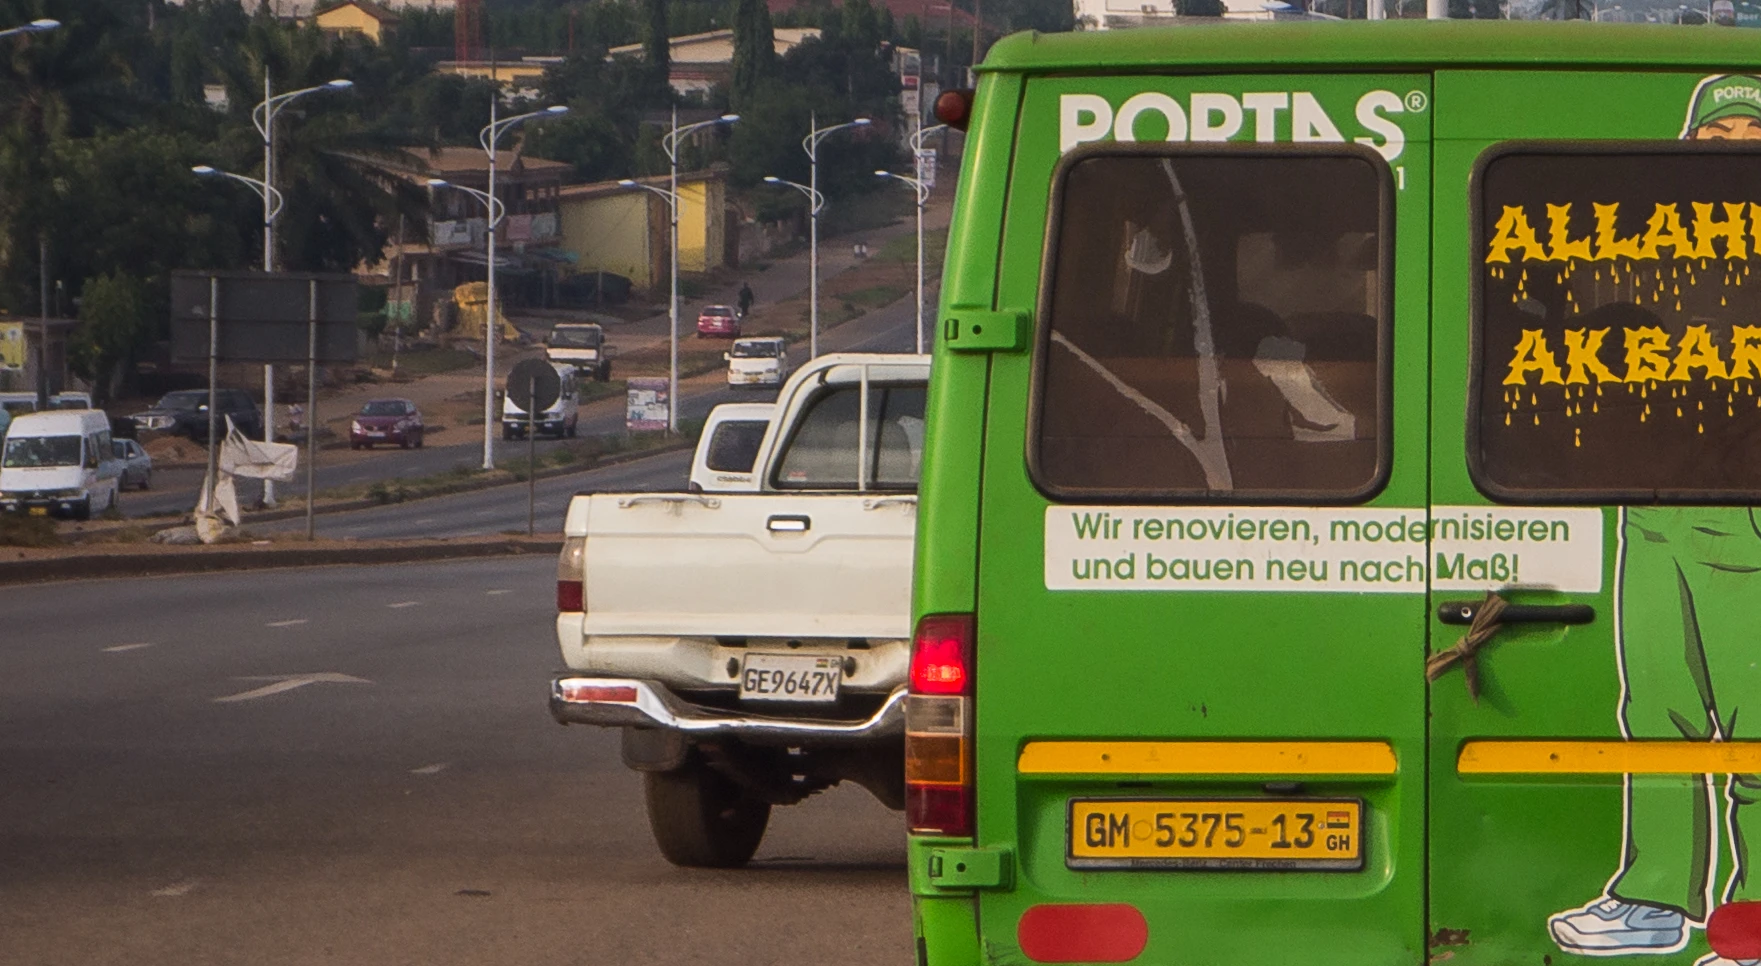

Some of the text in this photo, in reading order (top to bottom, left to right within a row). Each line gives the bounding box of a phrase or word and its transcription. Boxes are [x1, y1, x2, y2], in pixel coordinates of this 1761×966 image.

[1072, 513, 1569, 546] Wir renovieren, modernisieren
[1072, 552, 1519, 583] und bauen neu nach Maß!
[744, 668, 837, 696] GE9647X
[1085, 812, 1131, 848] GM
[1326, 835, 1350, 851] GH
